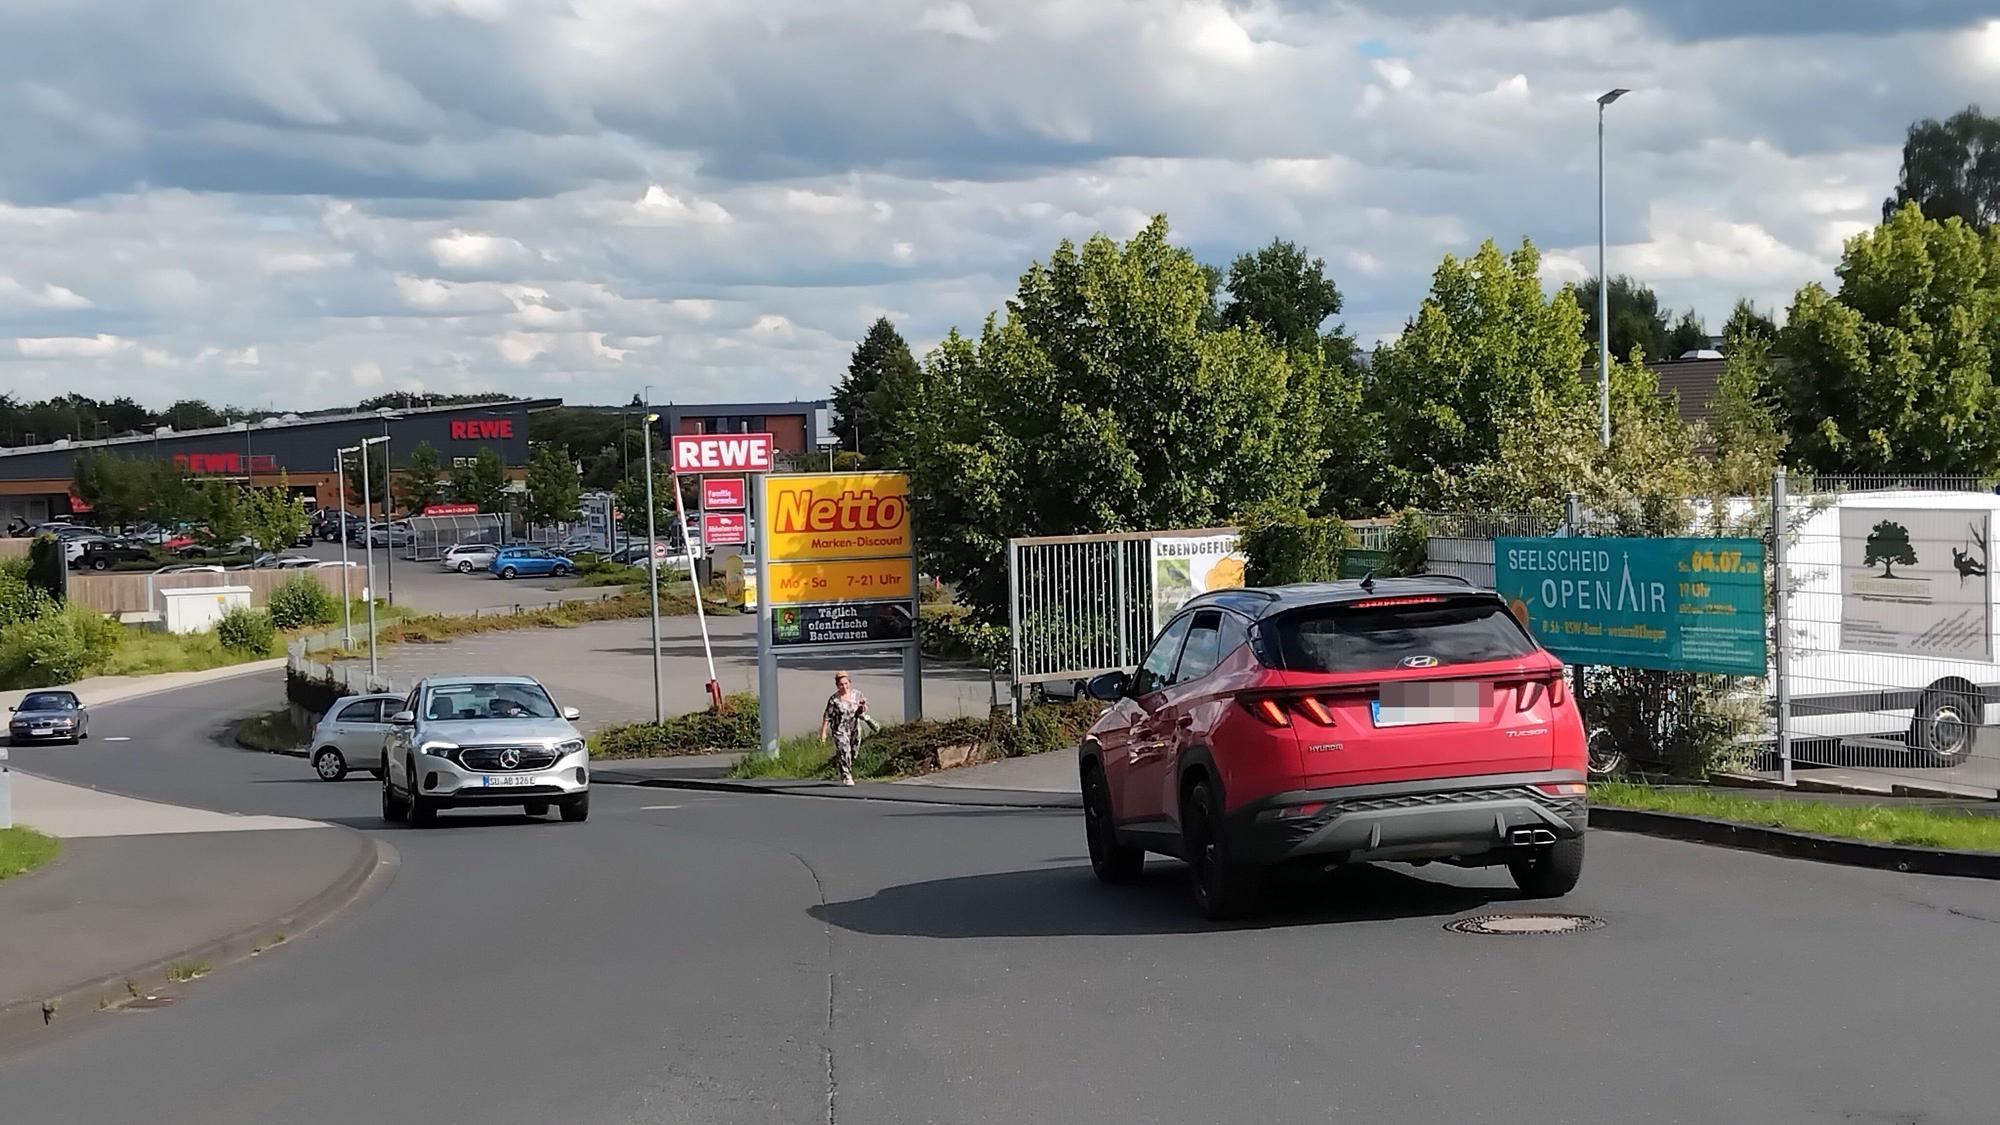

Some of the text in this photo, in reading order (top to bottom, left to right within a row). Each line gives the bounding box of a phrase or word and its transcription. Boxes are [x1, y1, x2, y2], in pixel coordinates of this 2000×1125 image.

[451, 419, 513, 439] REWE
[679, 439, 768, 468] REWE
[775, 489, 904, 534] Netto
[811, 536, 903, 549] Marken-Discount
[1157, 538, 1235, 556] LEBENDGEFLÜ
[1508, 549, 1610, 572] SEELSCHEID
[780, 578, 800, 589] Mo
[811, 577, 827, 588] Sa
[847, 575, 873, 586] 7-21
[880, 573, 902, 585] Uhr
[1541, 553, 1667, 613] OPEN AIR
[1692, 582, 1711, 598] Uhr
[818, 606, 858, 619] Täglich
[808, 619, 868, 631] ofenfrische
[809, 630, 868, 641] Backwaren
[1505, 728, 1548, 737] TUCSON
[1308, 743, 1343, 752] HYUNDAI
[490, 777, 500, 785] SU
[504, 776, 513, 785] AB
